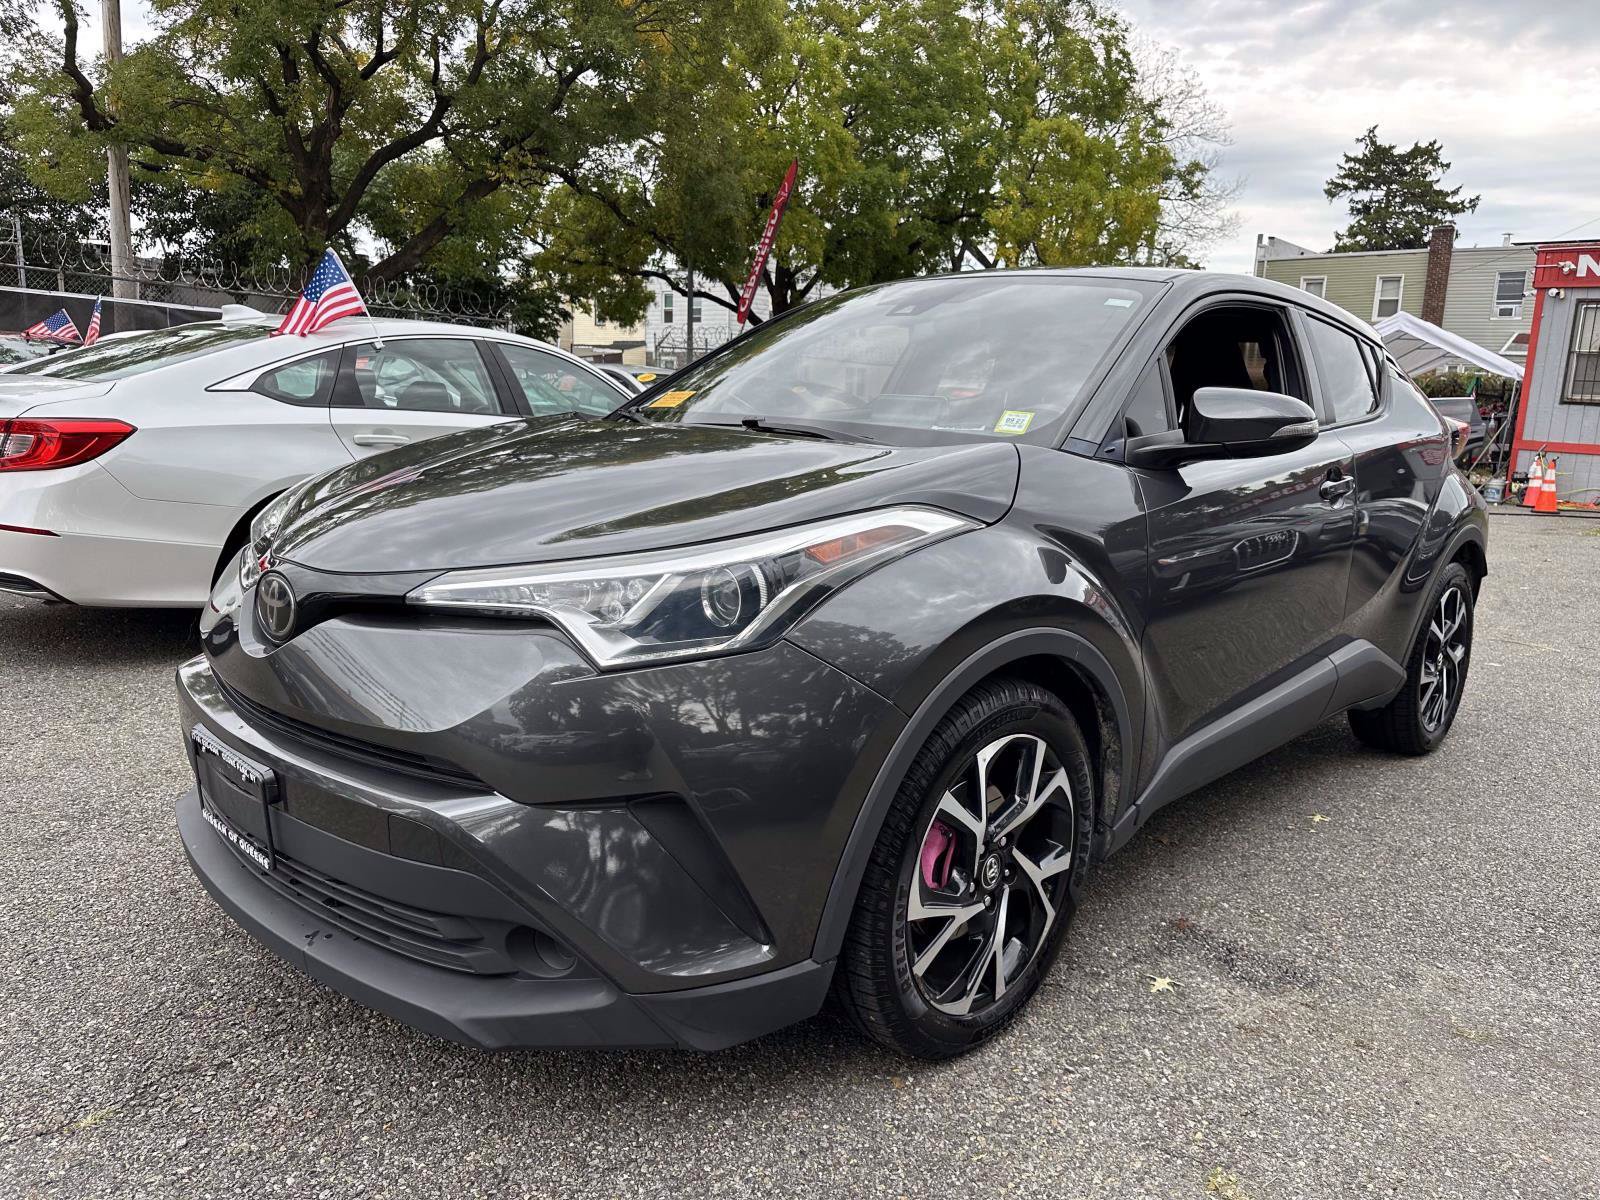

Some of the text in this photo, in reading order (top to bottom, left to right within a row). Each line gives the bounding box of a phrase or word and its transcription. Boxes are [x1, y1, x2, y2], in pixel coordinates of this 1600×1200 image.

[228, 829, 239, 844] OF
[239, 839, 269, 870] QUEENS
[895, 883, 913, 994] RELIANT
